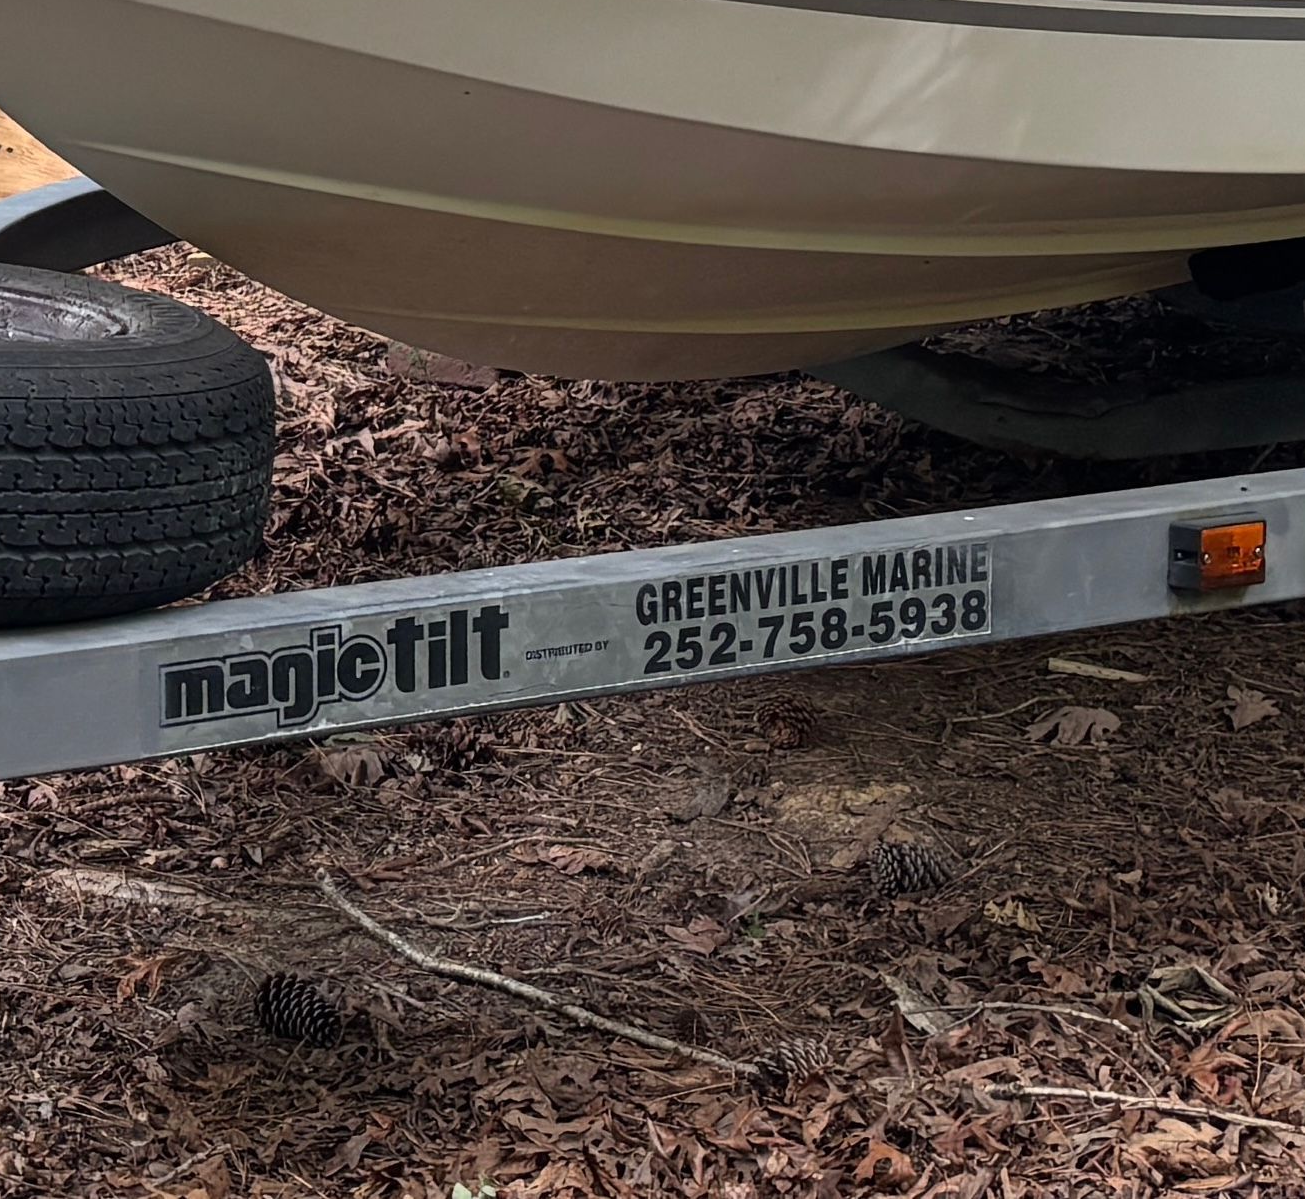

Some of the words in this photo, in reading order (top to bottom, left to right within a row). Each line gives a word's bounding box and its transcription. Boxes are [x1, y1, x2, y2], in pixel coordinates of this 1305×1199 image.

[636, 559, 849, 626] GREENVILLE
[862, 543, 988, 597] MARINE
[525, 642, 593, 660] DISTRIBUTED
[595, 639, 609, 651] BY
[644, 589, 987, 674] 252-758-5938
